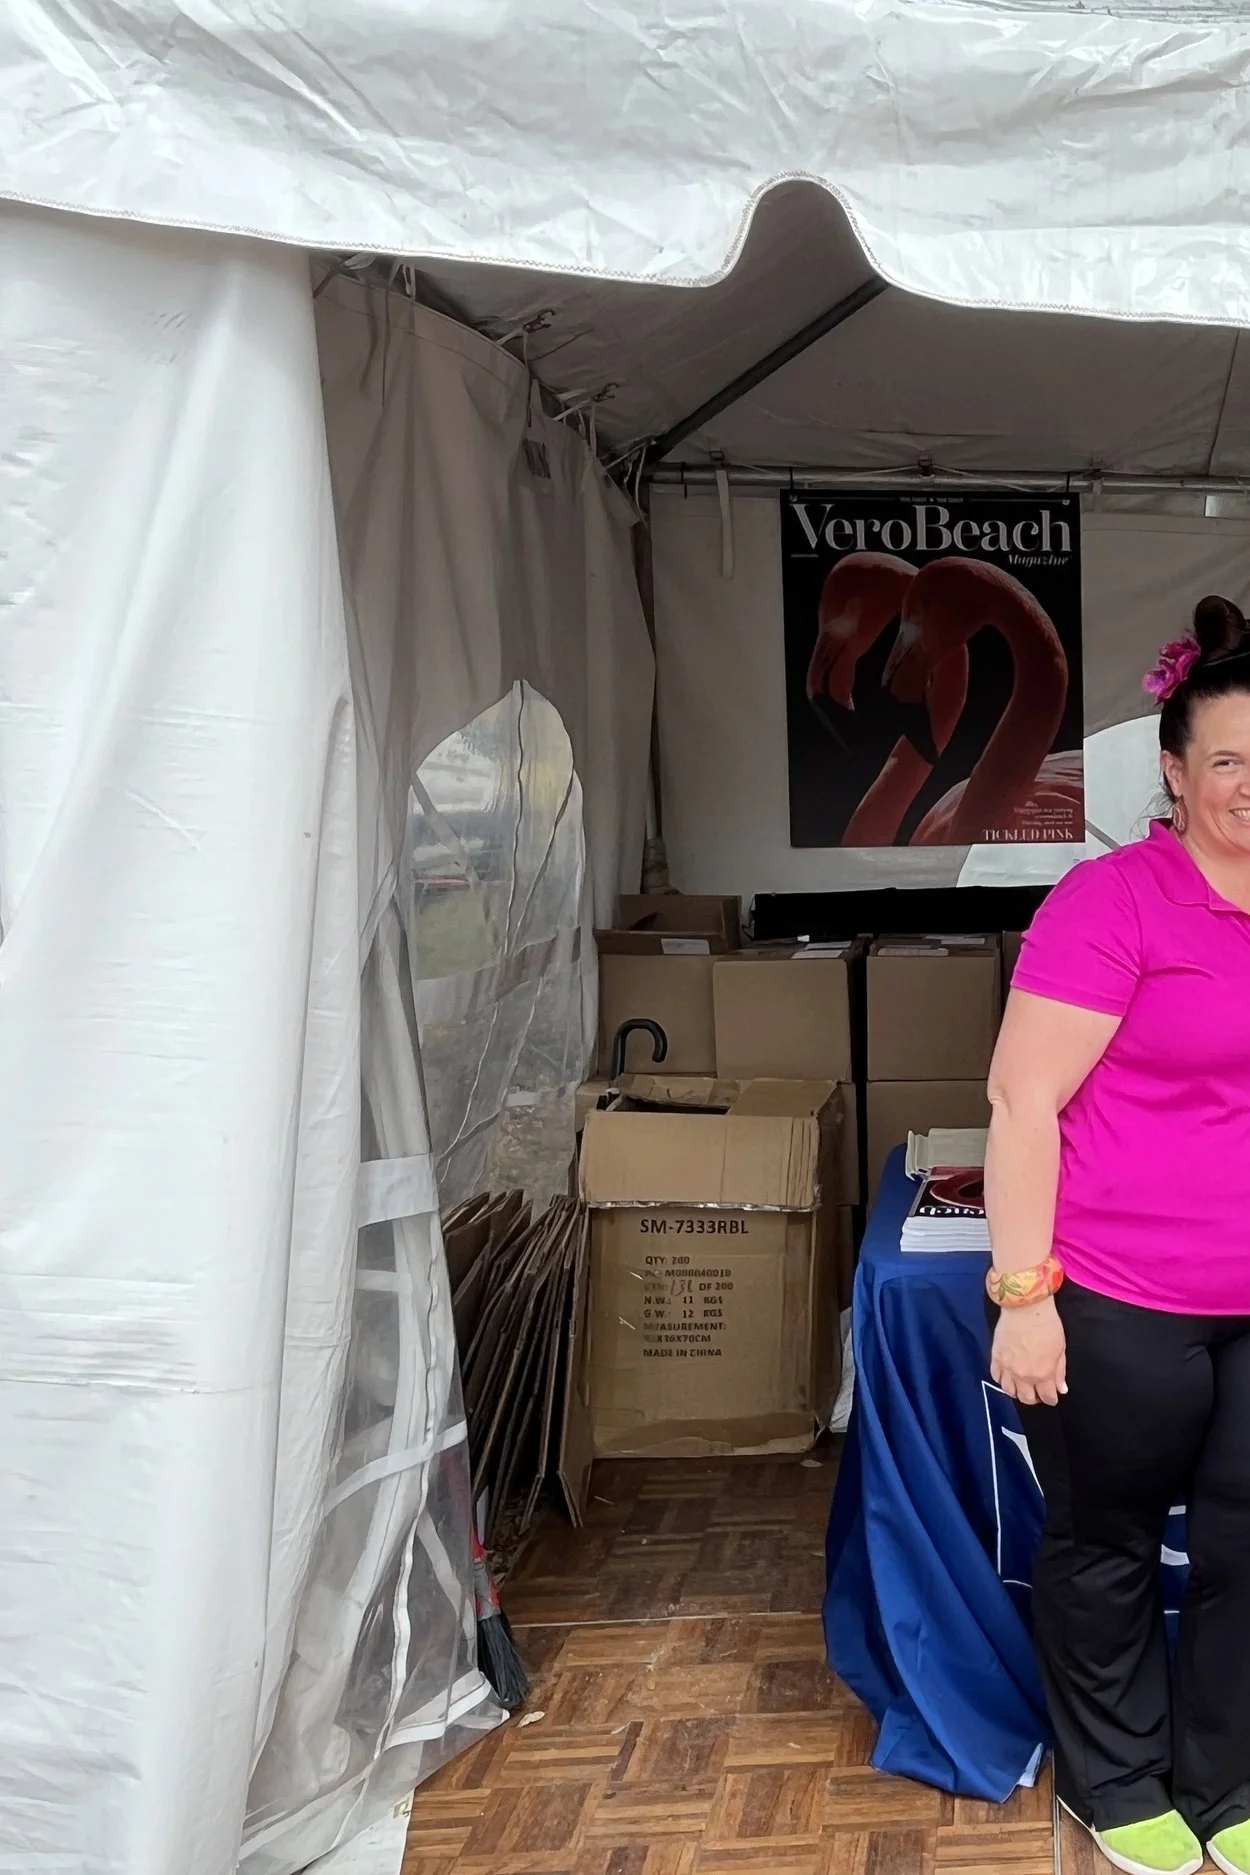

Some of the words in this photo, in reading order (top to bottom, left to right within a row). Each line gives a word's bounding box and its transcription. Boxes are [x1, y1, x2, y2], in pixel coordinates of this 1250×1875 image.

[788, 503, 1073, 552] VeroBeach
[1006, 553, 1070, 568] Magazine
[983, 828, 1040, 841] TICKLED
[1042, 828, 1074, 840] PINK
[639, 1218, 749, 1235] SM-7333RBL
[698, 1282, 713, 1292] OF
[714, 1282, 734, 1291] 200
[682, 1295, 694, 1305] 11
[682, 1309, 695, 1319] 12
[642, 1348, 673, 1358] MADE
[675, 1348, 688, 1358] IN
[689, 1348, 723, 1358] CHINA
